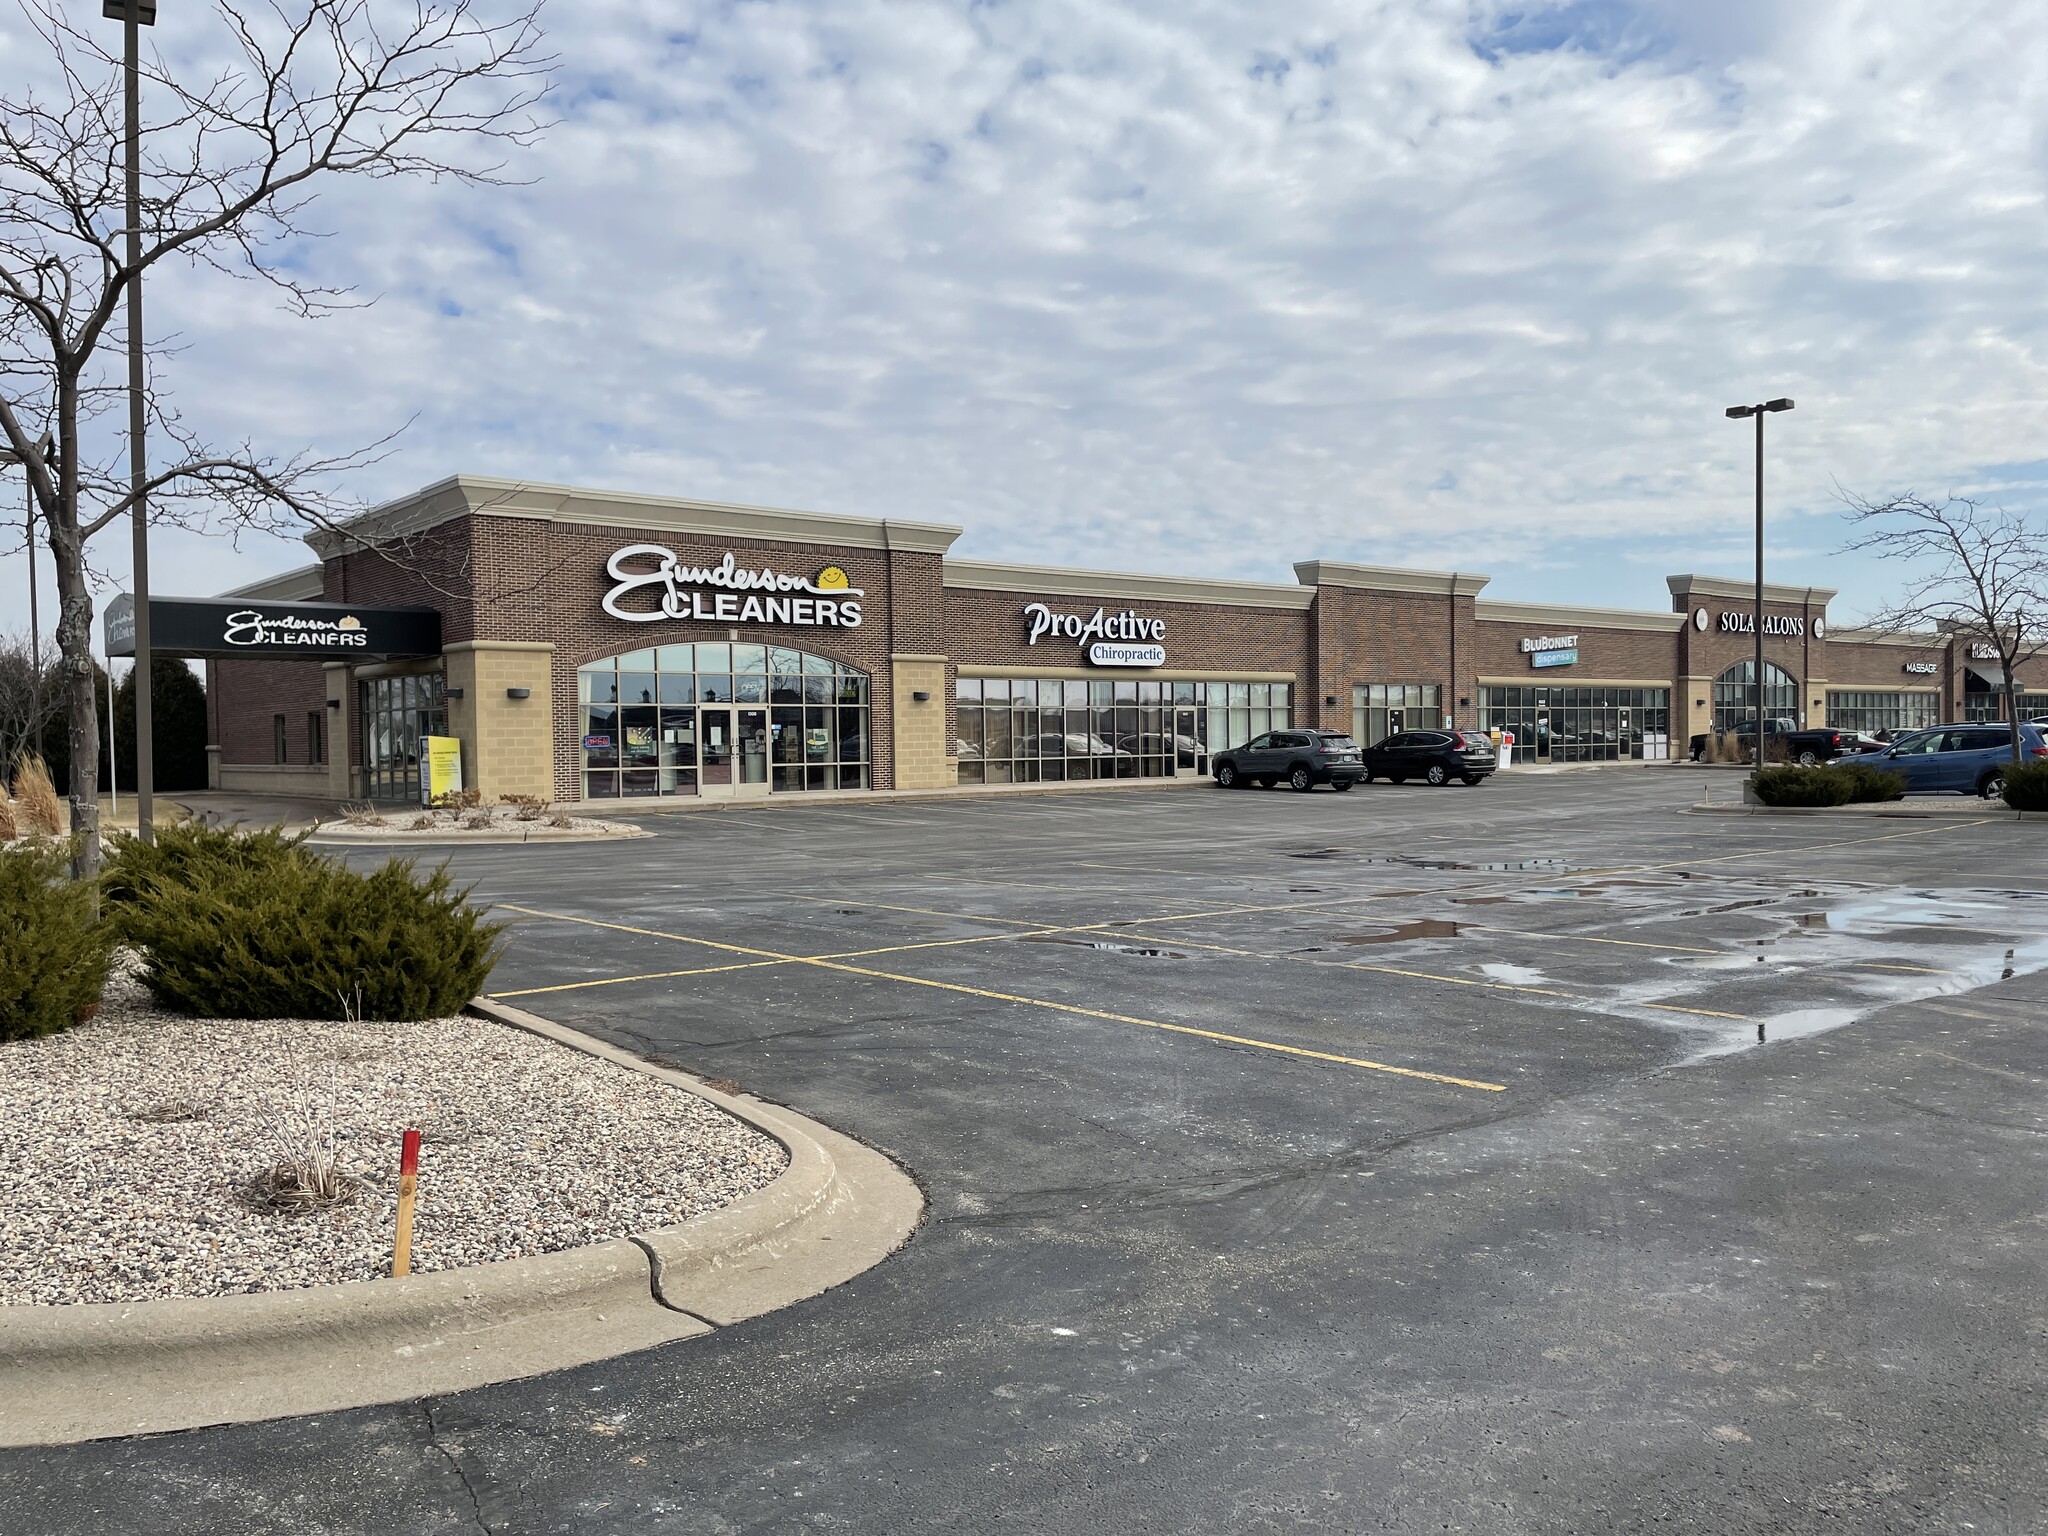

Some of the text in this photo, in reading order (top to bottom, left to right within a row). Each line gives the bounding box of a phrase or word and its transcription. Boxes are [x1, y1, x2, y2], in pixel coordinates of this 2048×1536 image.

[602, 544, 864, 622] Gunderson
[662, 592, 862, 627] CLEANERS
[223, 610, 367, 645] Gunderson
[1024, 603, 1166, 646] ProActive
[1721, 611, 1755, 632] SOLA
[255, 631, 367, 646] CLEANERS
[1093, 646, 1162, 662] Chiropractic
[1536, 652, 1578, 664] dispensary
[1906, 662, 1938, 674] MASSAGE
[587, 738, 609, 746] OPEN
